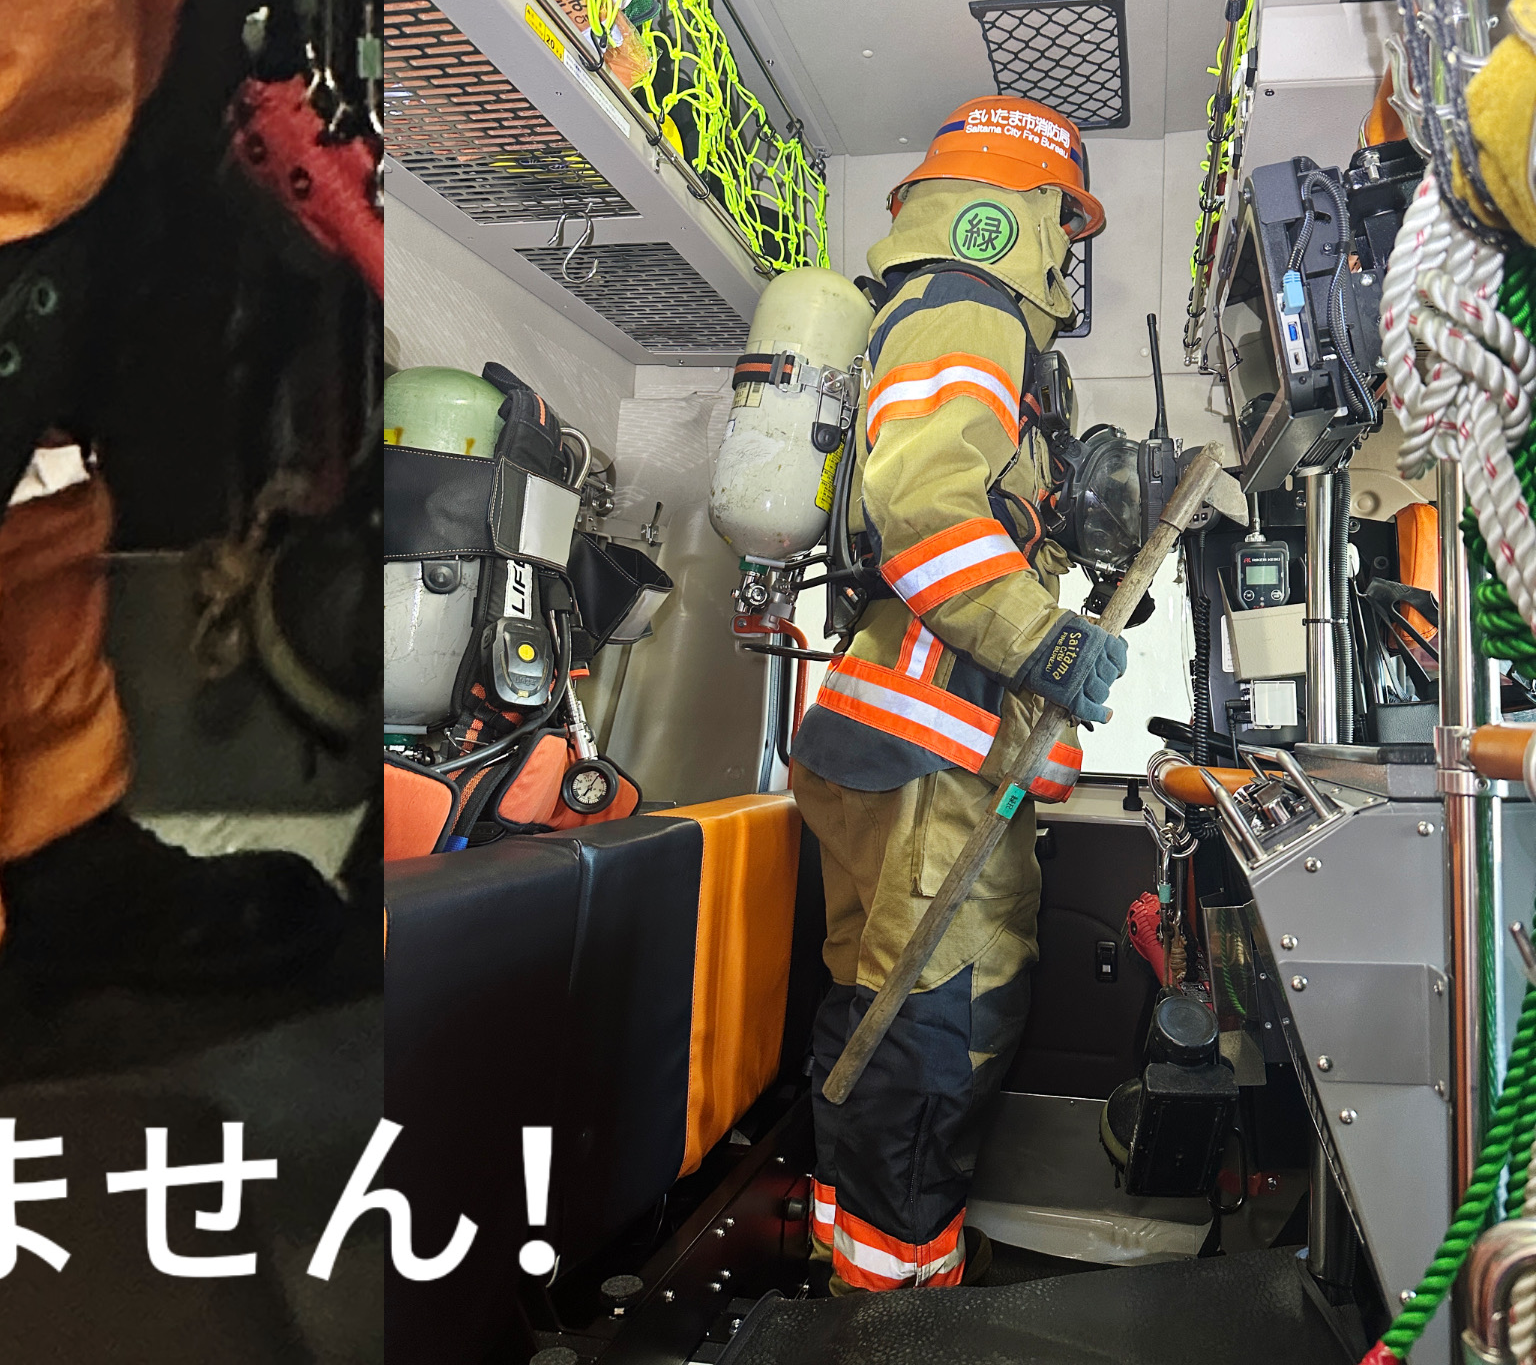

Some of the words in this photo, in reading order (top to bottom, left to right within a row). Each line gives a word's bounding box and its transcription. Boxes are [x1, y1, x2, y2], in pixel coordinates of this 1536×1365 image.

[965, 124, 1002, 134] Saitama
[1004, 126, 1022, 138] City
[1023, 130, 1040, 144] Fire
[1040, 137, 1069, 159] Bureau
[967, 108, 1070, 149] さいたま市消防局
[962, 212, 1002, 252] 緑
[511, 560, 526, 615] LIF
[1052, 632, 1082, 680] Saitama
[1057, 631, 1068, 645] FIRE
[1045, 646, 1062, 672] BUREAU
